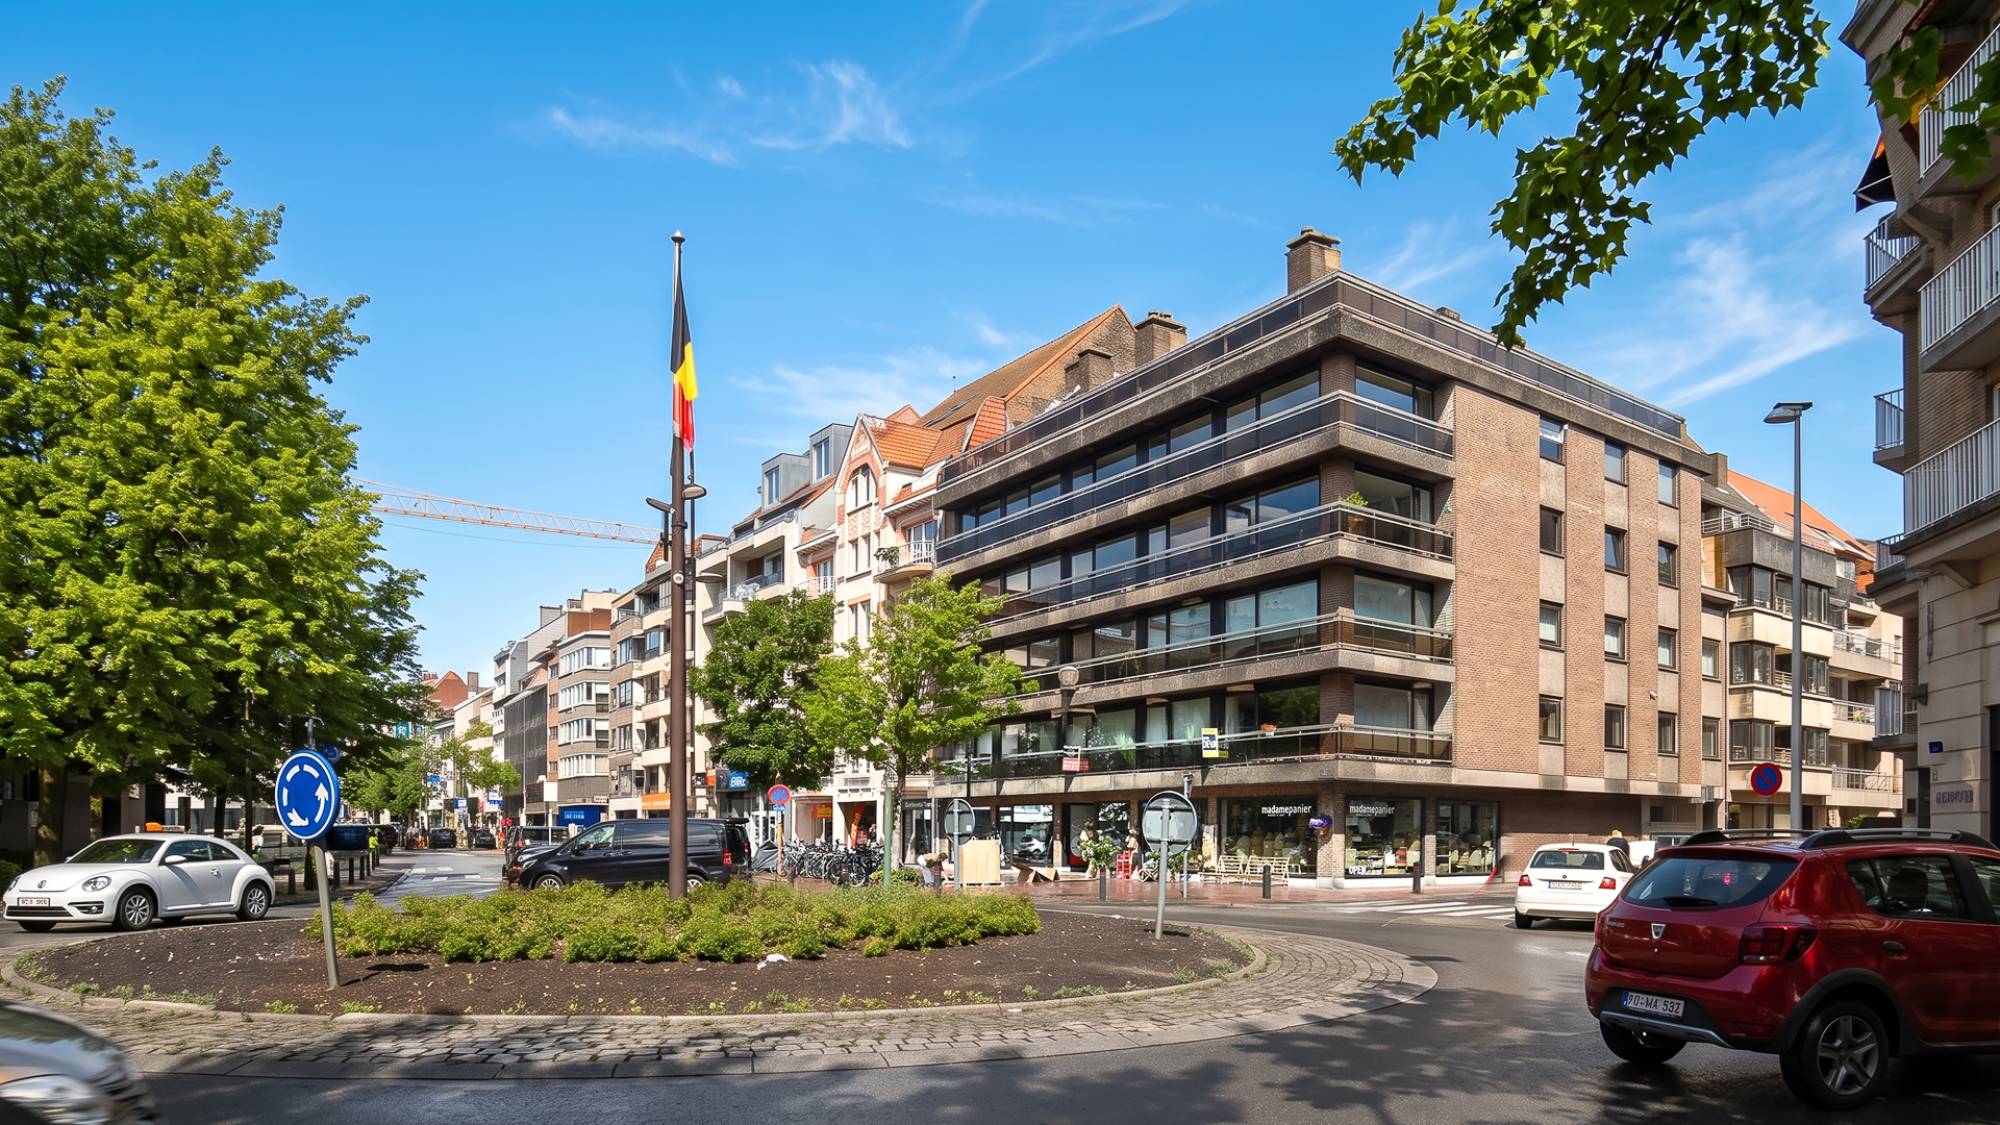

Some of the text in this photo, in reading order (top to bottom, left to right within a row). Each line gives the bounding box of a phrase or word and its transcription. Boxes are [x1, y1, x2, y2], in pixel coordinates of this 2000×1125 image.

[1261, 803, 1312, 816] madamepanier
[1349, 804, 1395, 816] madamepanier
[1348, 866, 1366, 874] OPEN
